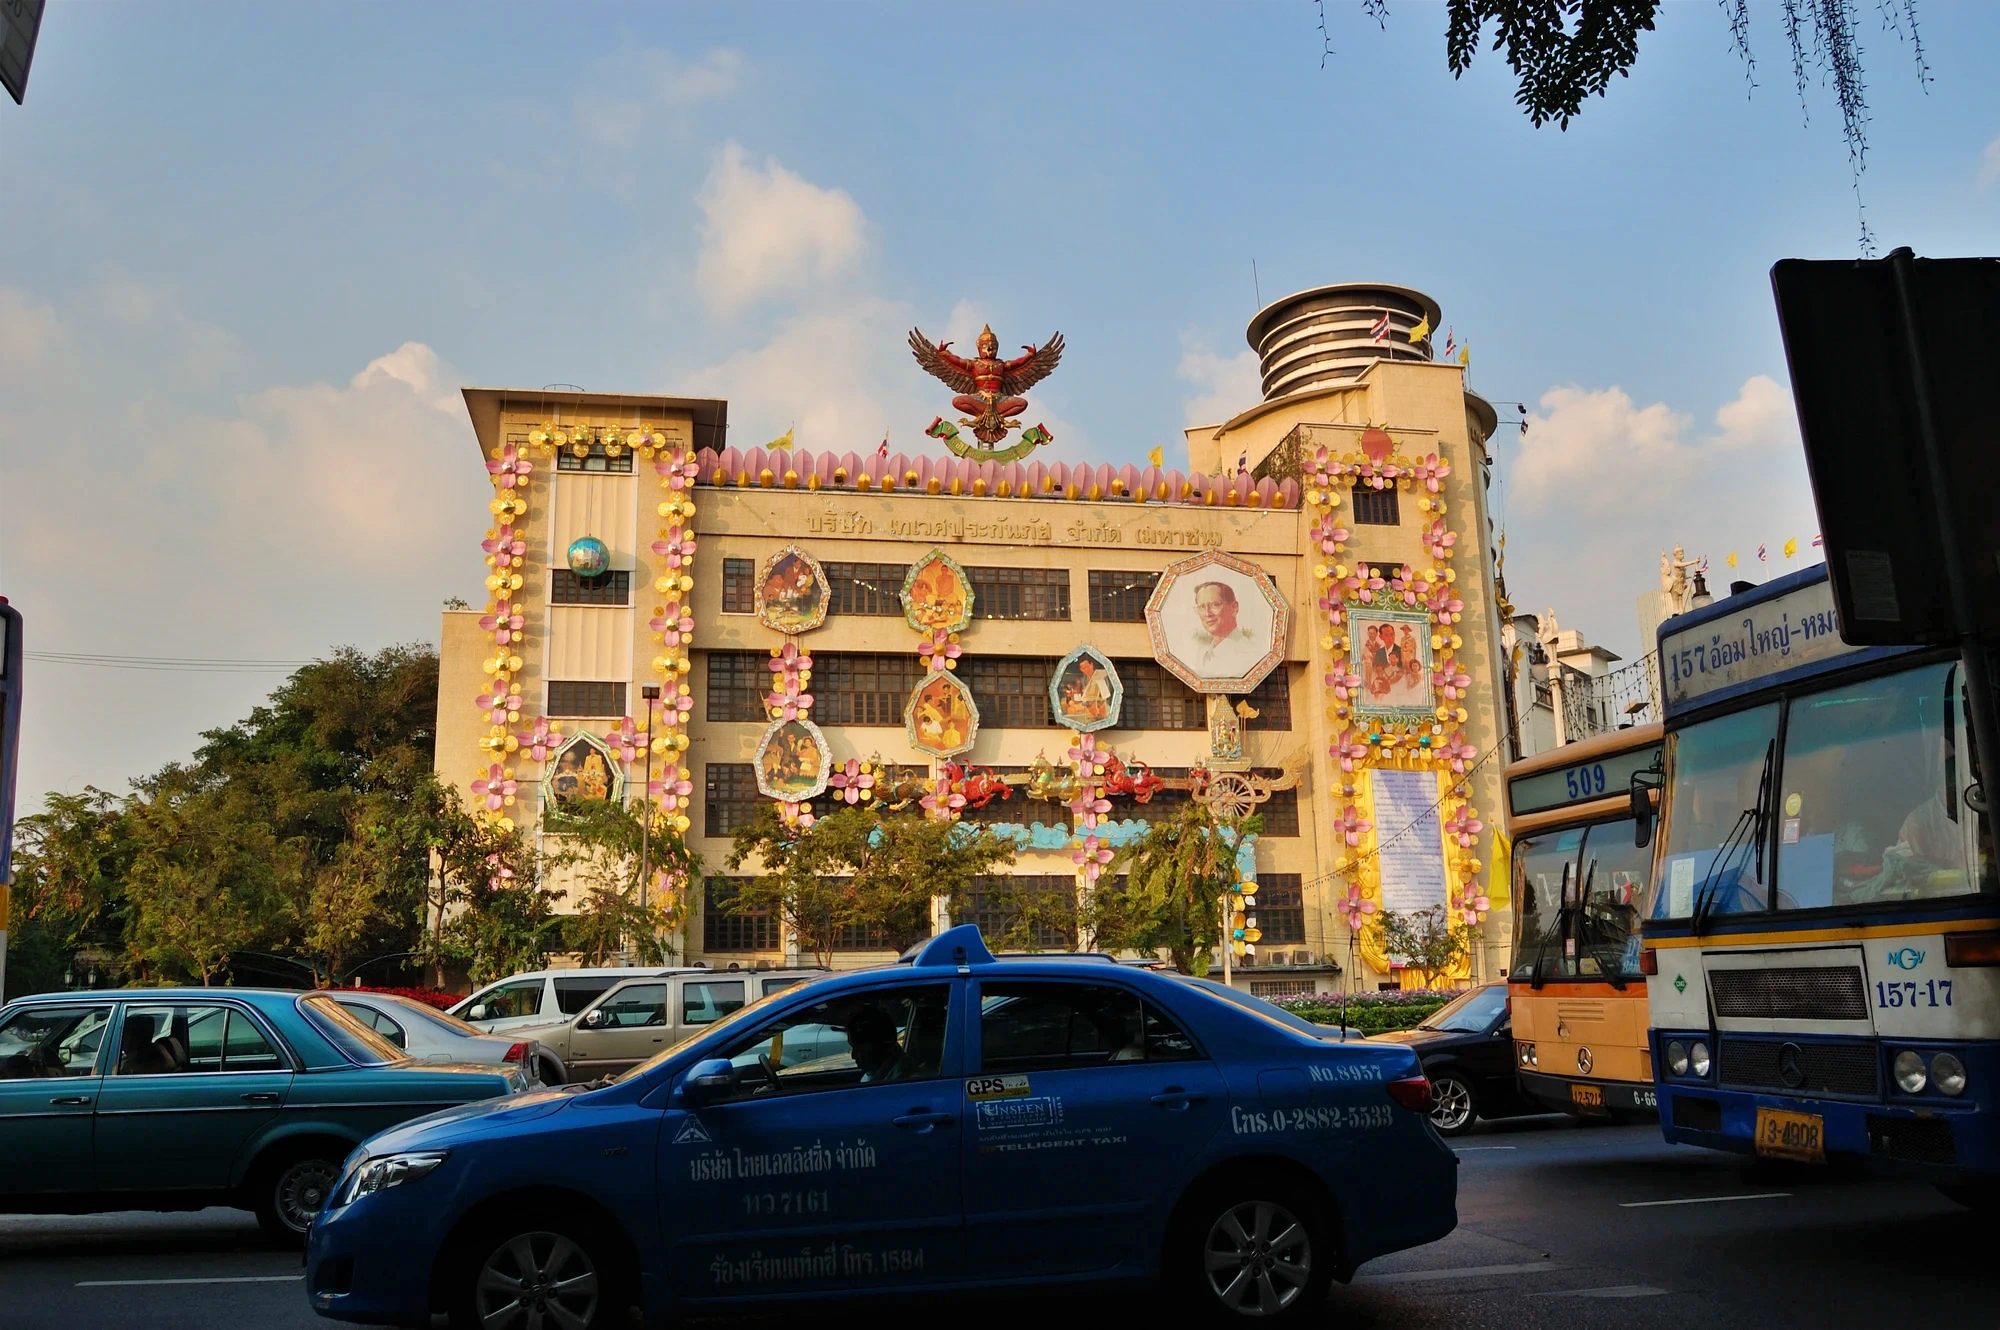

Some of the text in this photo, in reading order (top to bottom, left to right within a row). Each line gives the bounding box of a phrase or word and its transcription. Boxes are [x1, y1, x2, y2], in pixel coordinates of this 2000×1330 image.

[807, 510, 873, 534] บริษัท
[1067, 519, 1122, 543] จำกัด
[1670, 644, 1706, 683] 157
[1566, 763, 1606, 799] 509
[1887, 947, 1926, 970] NGV
[1876, 979, 1952, 1008] 157-17
[966, 1077, 1005, 1095] GPS
[1308, 1064, 1383, 1082] No.8957
[1091, 1136, 1127, 1145] TAXI
[690, 1149, 732, 1181] บริษัท
[836, 1138, 876, 1169] จำกัด
